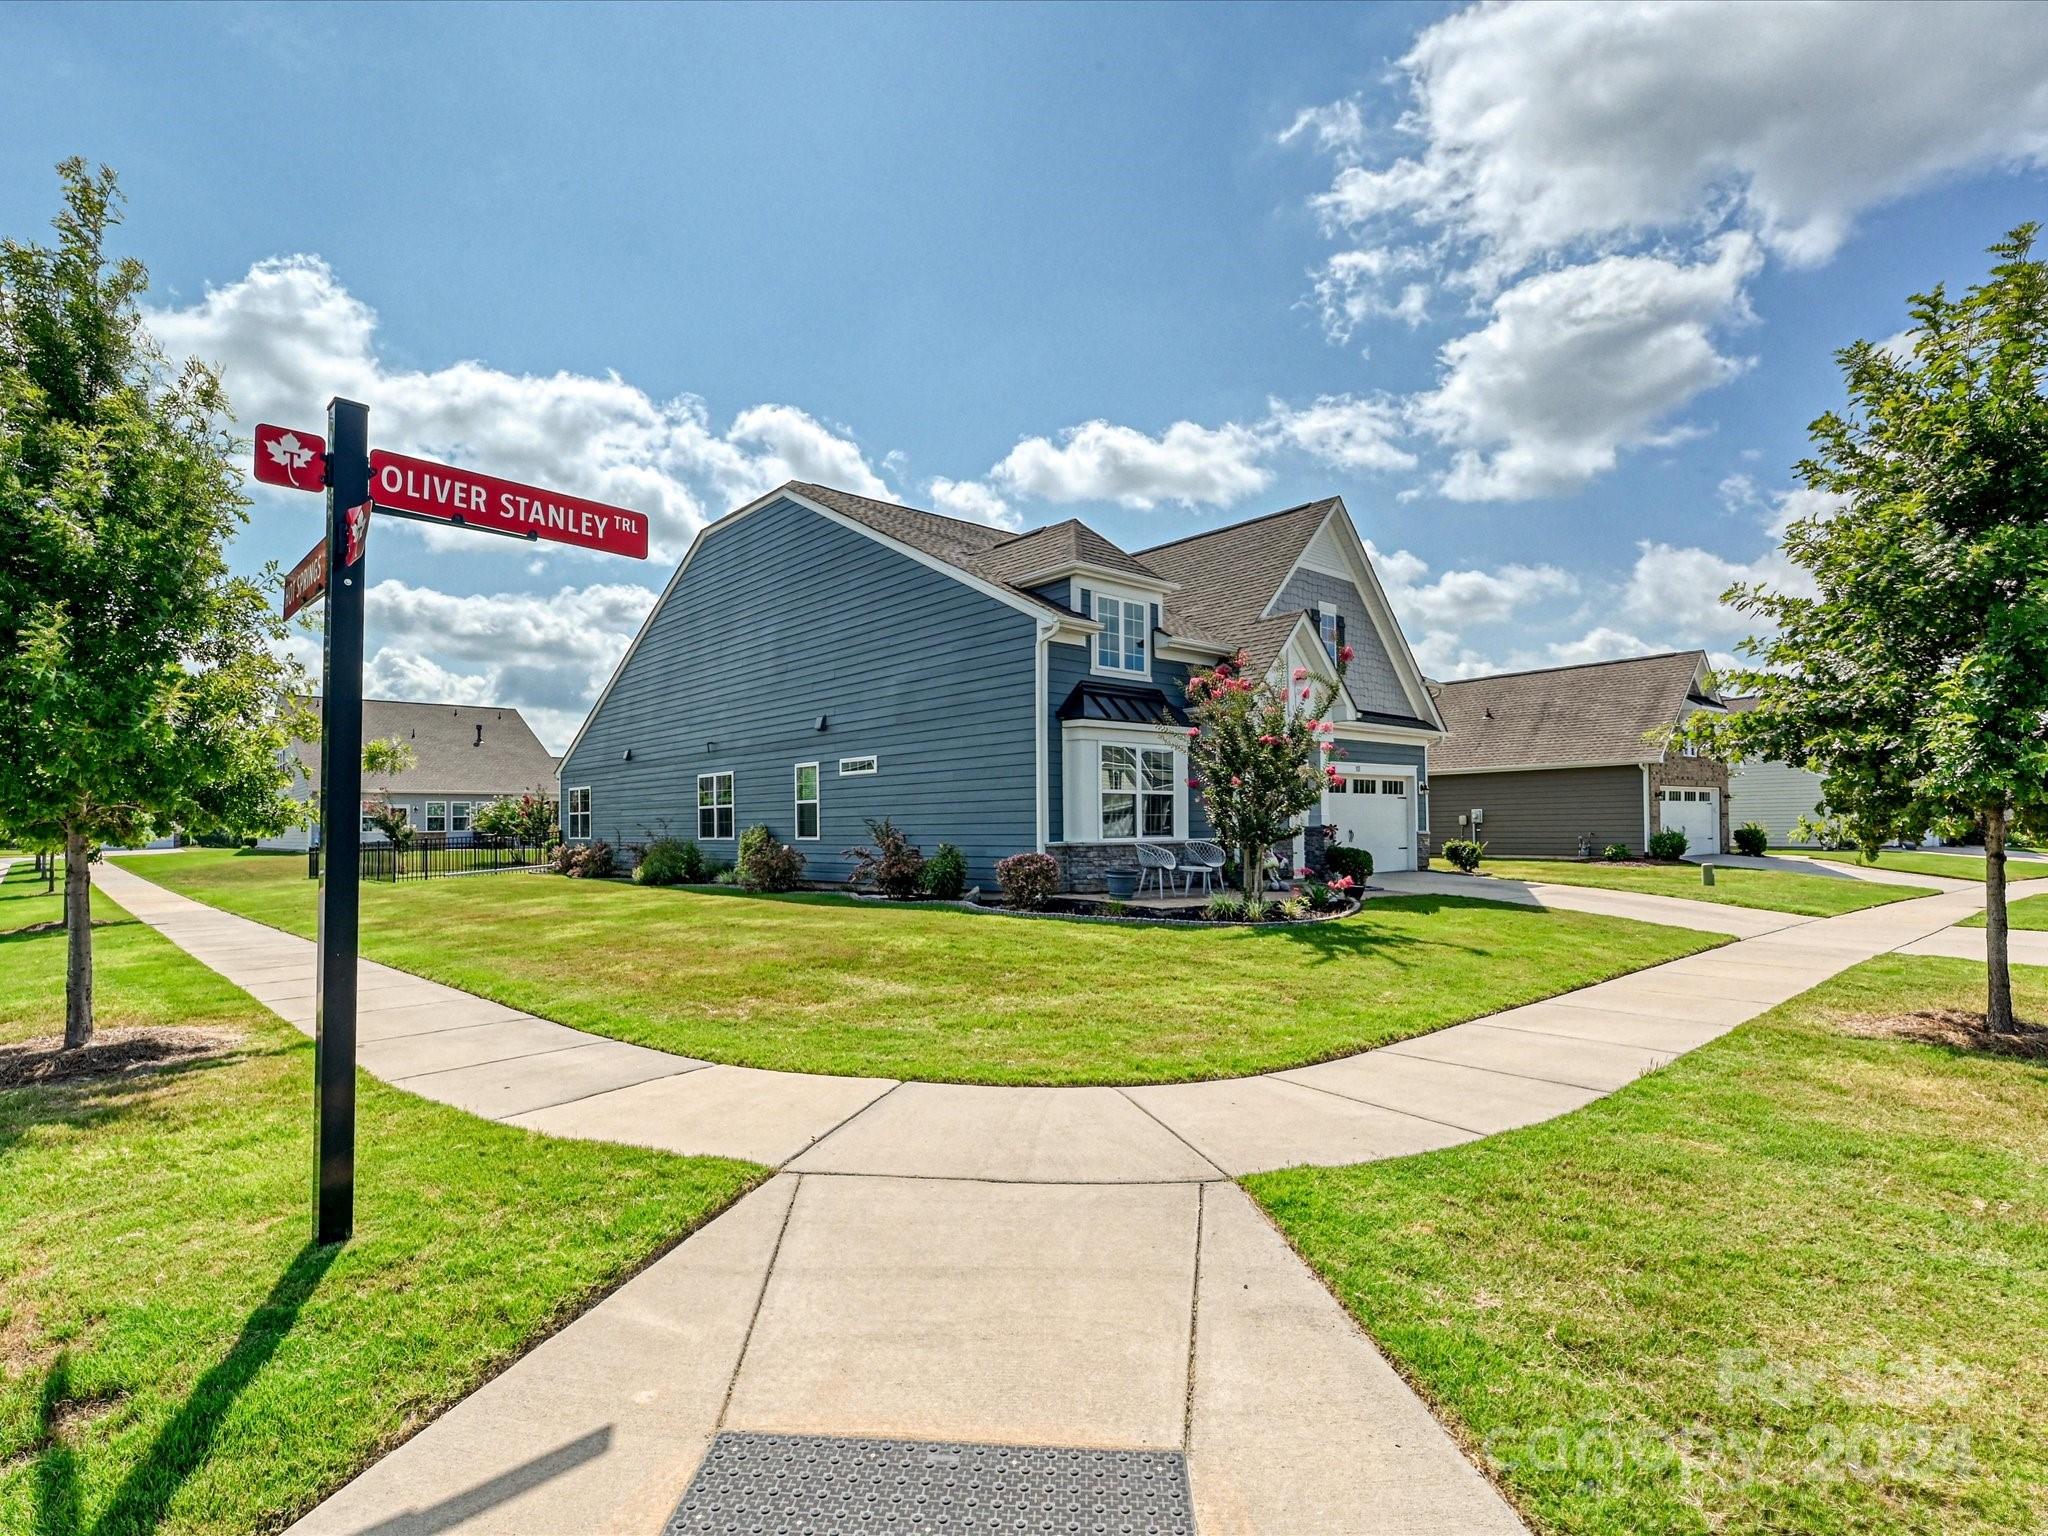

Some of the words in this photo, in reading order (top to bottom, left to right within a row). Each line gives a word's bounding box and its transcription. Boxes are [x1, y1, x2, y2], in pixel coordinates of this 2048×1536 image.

[381, 465, 487, 513] OLIVER
[499, 493, 609, 539] STANLEY
[613, 515, 639, 534] TRL
[296, 554, 322, 598] SPRINGS
